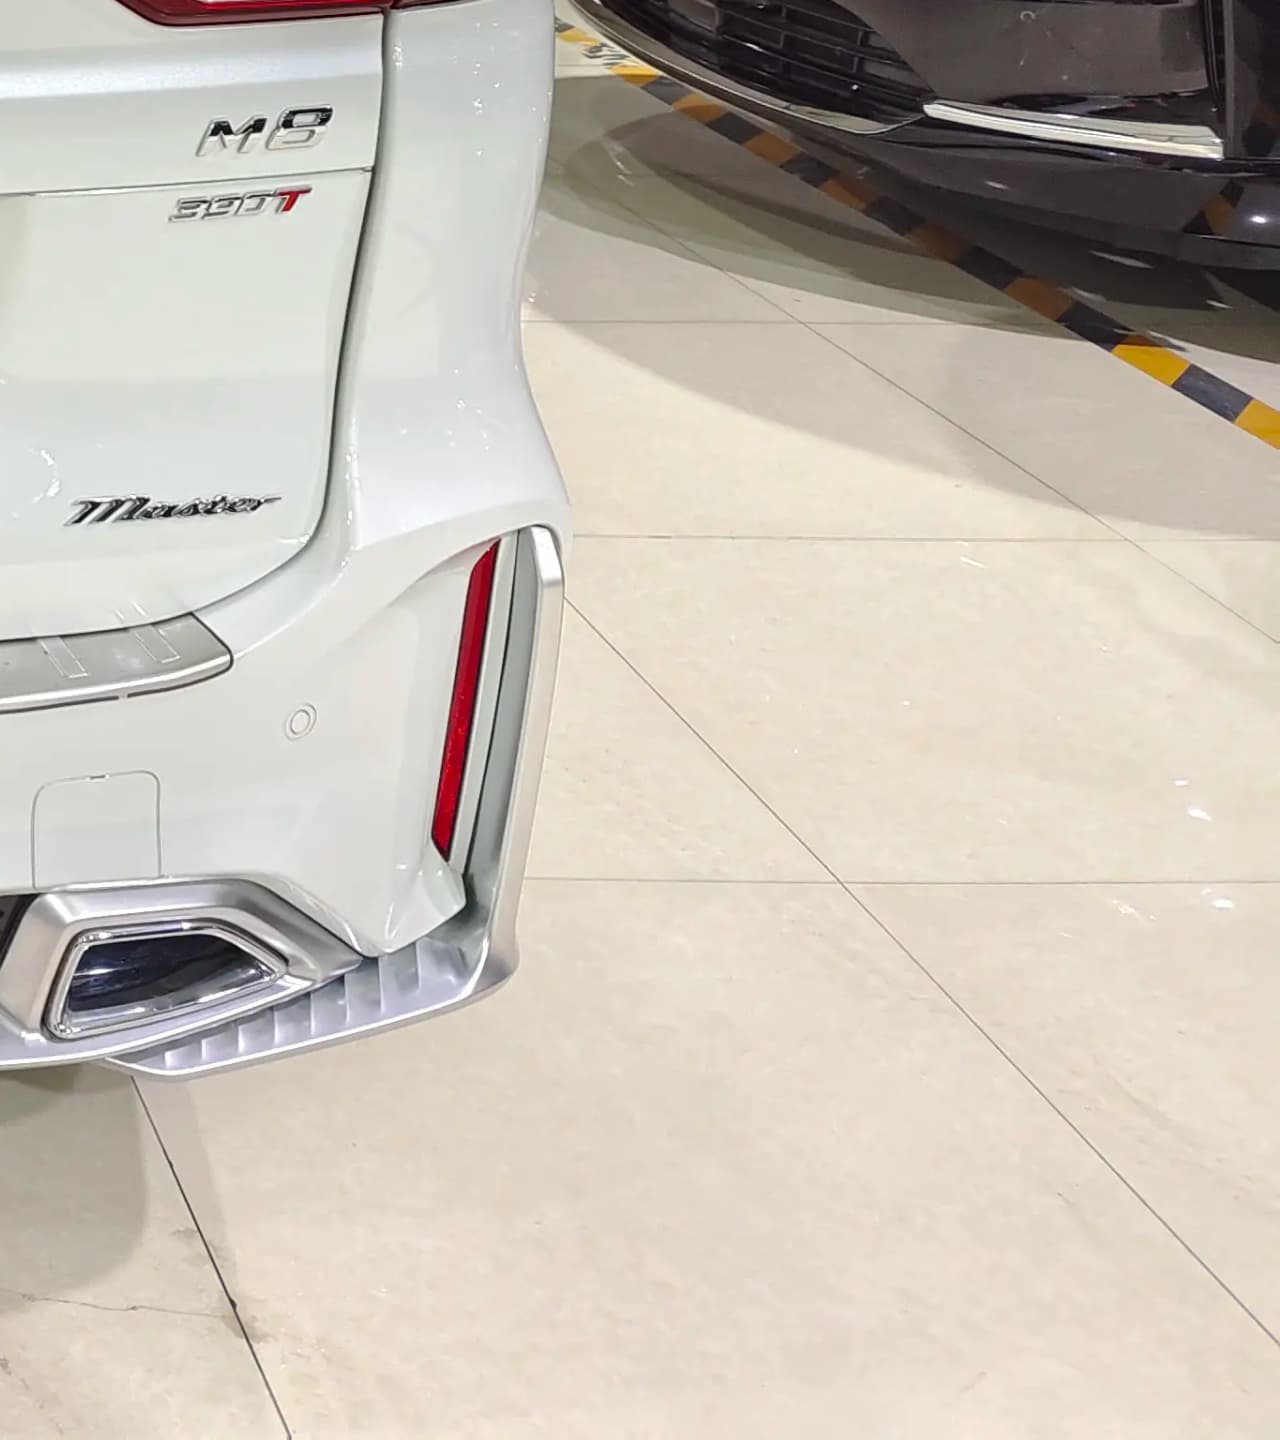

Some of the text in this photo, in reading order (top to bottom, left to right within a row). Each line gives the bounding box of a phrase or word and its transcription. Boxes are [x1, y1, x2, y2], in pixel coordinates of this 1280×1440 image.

[195, 104, 334, 158] M8
[167, 184, 313, 224] 390T
[63, 494, 282, 527] Master
